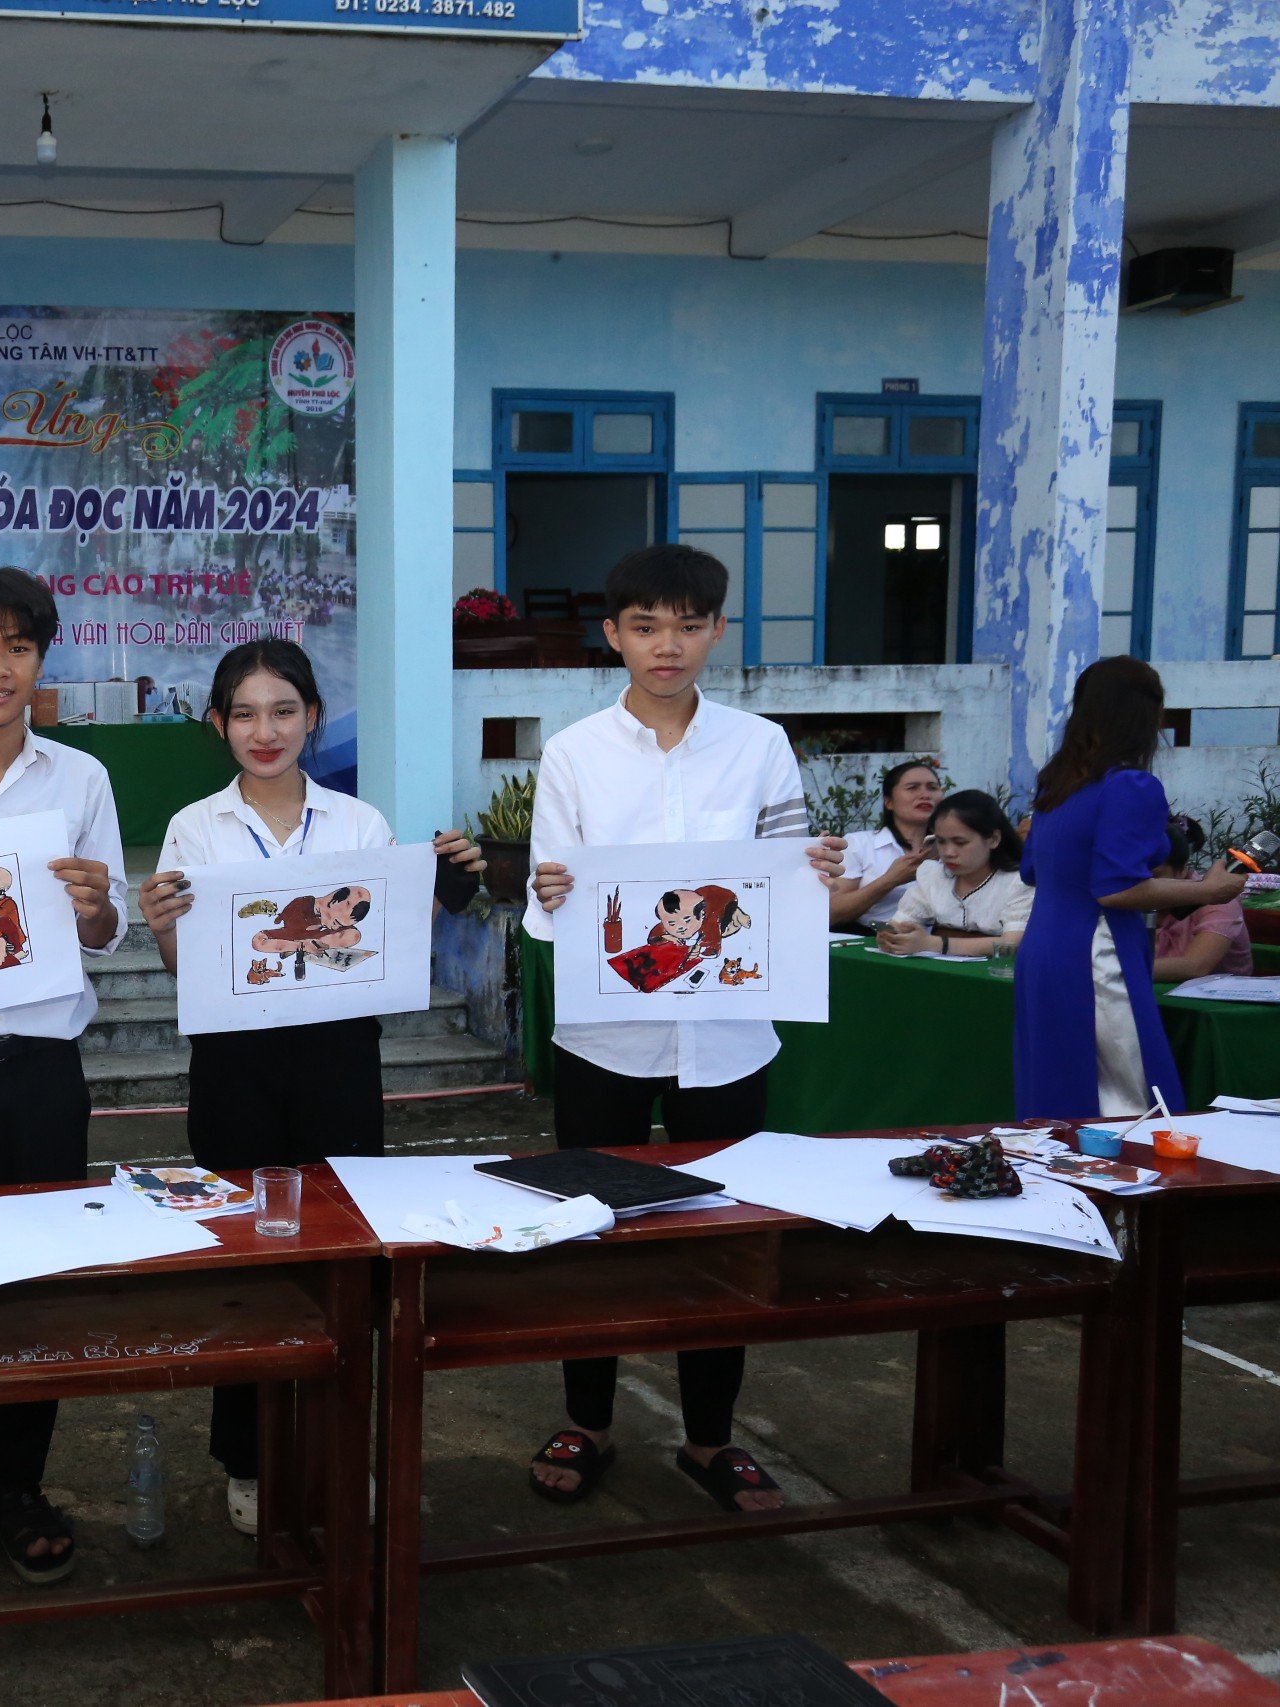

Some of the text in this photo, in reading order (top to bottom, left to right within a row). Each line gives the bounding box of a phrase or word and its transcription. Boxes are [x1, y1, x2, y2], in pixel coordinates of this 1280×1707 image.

[28, 342, 67, 361] TÂM
[72, 346, 159, 361] VH-TT&TT
[1, 380, 123, 454] Ứng
[48, 487, 128, 545] ĐỌC
[133, 474, 217, 531] NĂM
[222, 487, 321, 533] 2024
[82, 574, 143, 596] CAO
[149, 569, 193, 596] TRÍ
[71, 618, 107, 646] VĂN
[116, 617, 166, 645] HÓA
[175, 616, 213, 645] DÂN
[220, 621, 259, 644] GIAN
